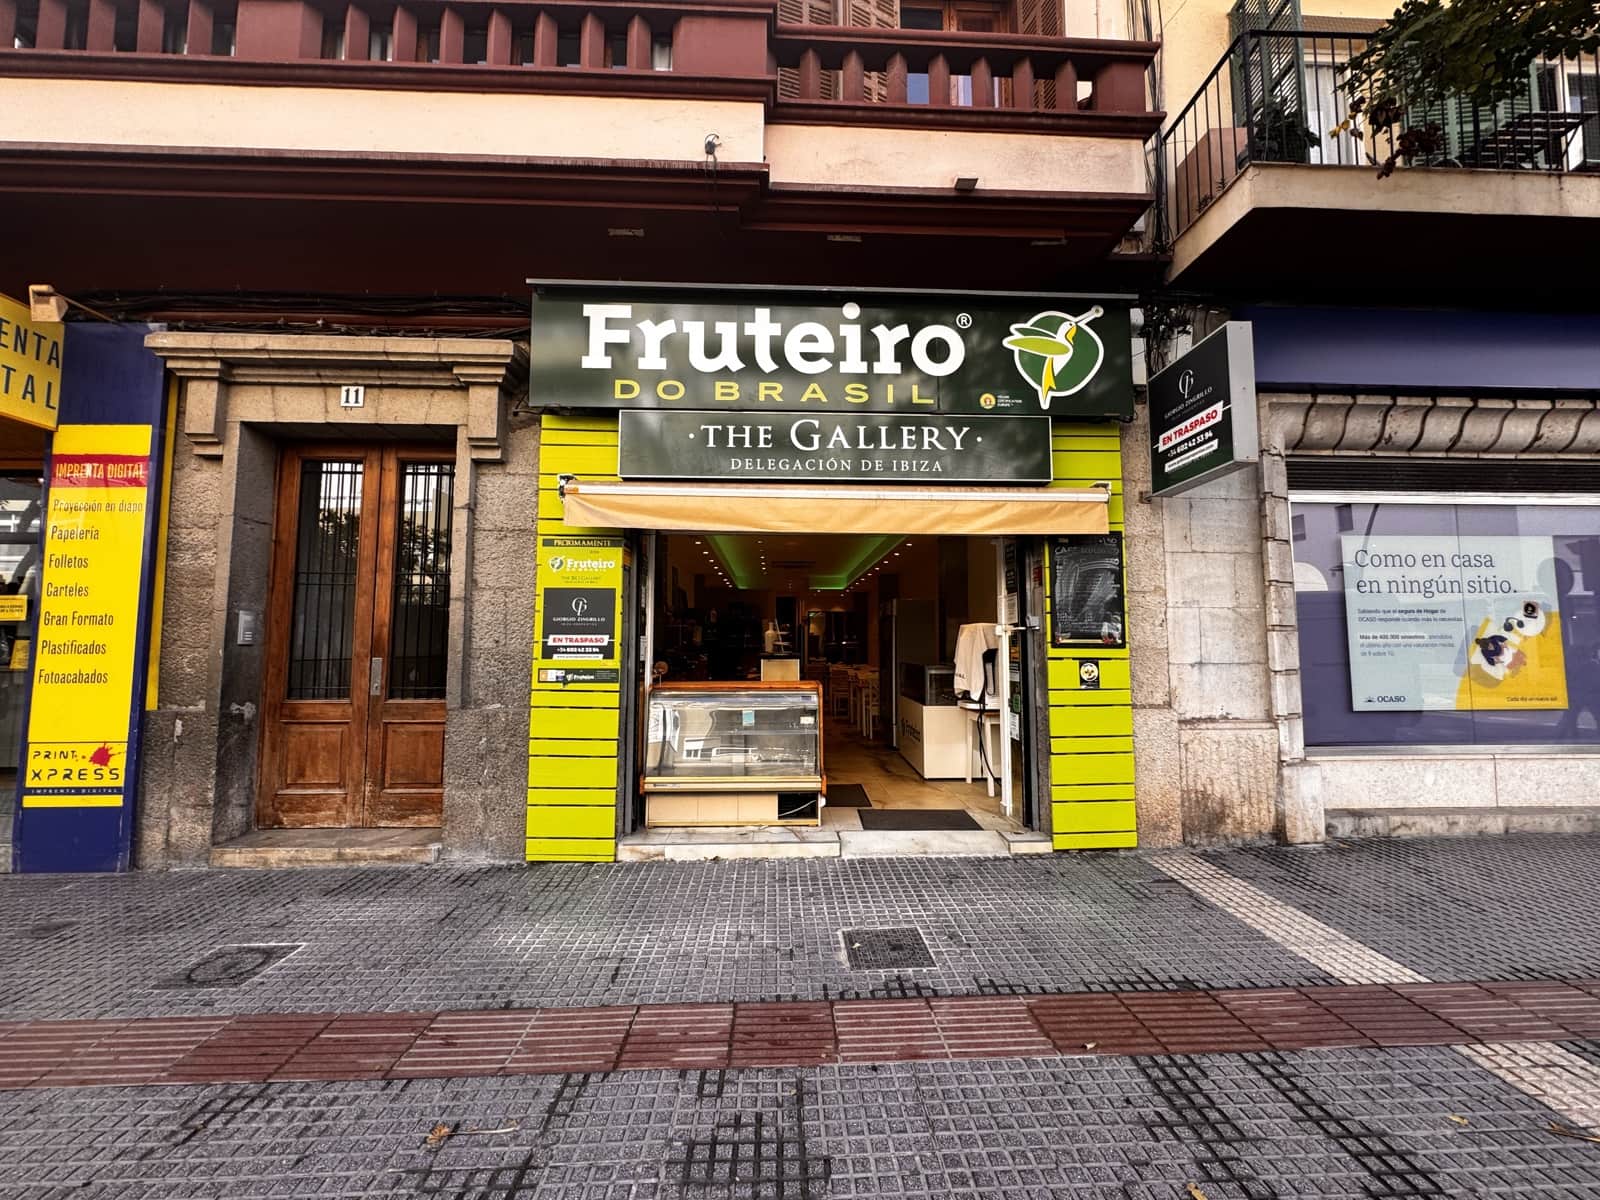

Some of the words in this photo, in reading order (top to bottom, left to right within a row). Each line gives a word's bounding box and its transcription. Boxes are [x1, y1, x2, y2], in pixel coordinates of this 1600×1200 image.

[1, 364, 57, 410] TAL
[614, 379, 686, 400] DO
[714, 381, 934, 404] BRASIL
[344, 387, 360, 404] 11
[700, 425, 773, 448] THE
[790, 419, 971, 451] GALLERY
[1162, 432, 1173, 446] EN
[1173, 409, 1218, 439] TRASPASO
[56, 463, 104, 479] IMPRENTA
[107, 463, 145, 479] DIGITAL
[730, 457, 851, 471] DELEGACIÓN
[861, 460, 884, 471] DE
[893, 460, 943, 472] IBIZA
[53, 499, 102, 514] Proyección
[105, 503, 116, 512] en
[50, 525, 100, 542] Papelería
[48, 553, 89, 569] Folletos
[566, 558, 616, 569] Fruteiro
[1355, 550, 1417, 568] Como
[1421, 553, 1447, 568] en
[1451, 553, 1496, 568] casa
[46, 582, 89, 597] Carteles
[1356, 578, 1382, 594] en
[1386, 574, 1467, 599] ningún
[1467, 575, 1518, 594] sitio.
[43, 610, 68, 626] Gran
[71, 610, 114, 626] Formato
[41, 639, 106, 655] Plastificados
[38, 668, 109, 684] Fotoacabados
[1377, 695, 1406, 703] OCASO
[33, 750, 76, 760] PRINT
[31, 768, 120, 781] XPRESS
